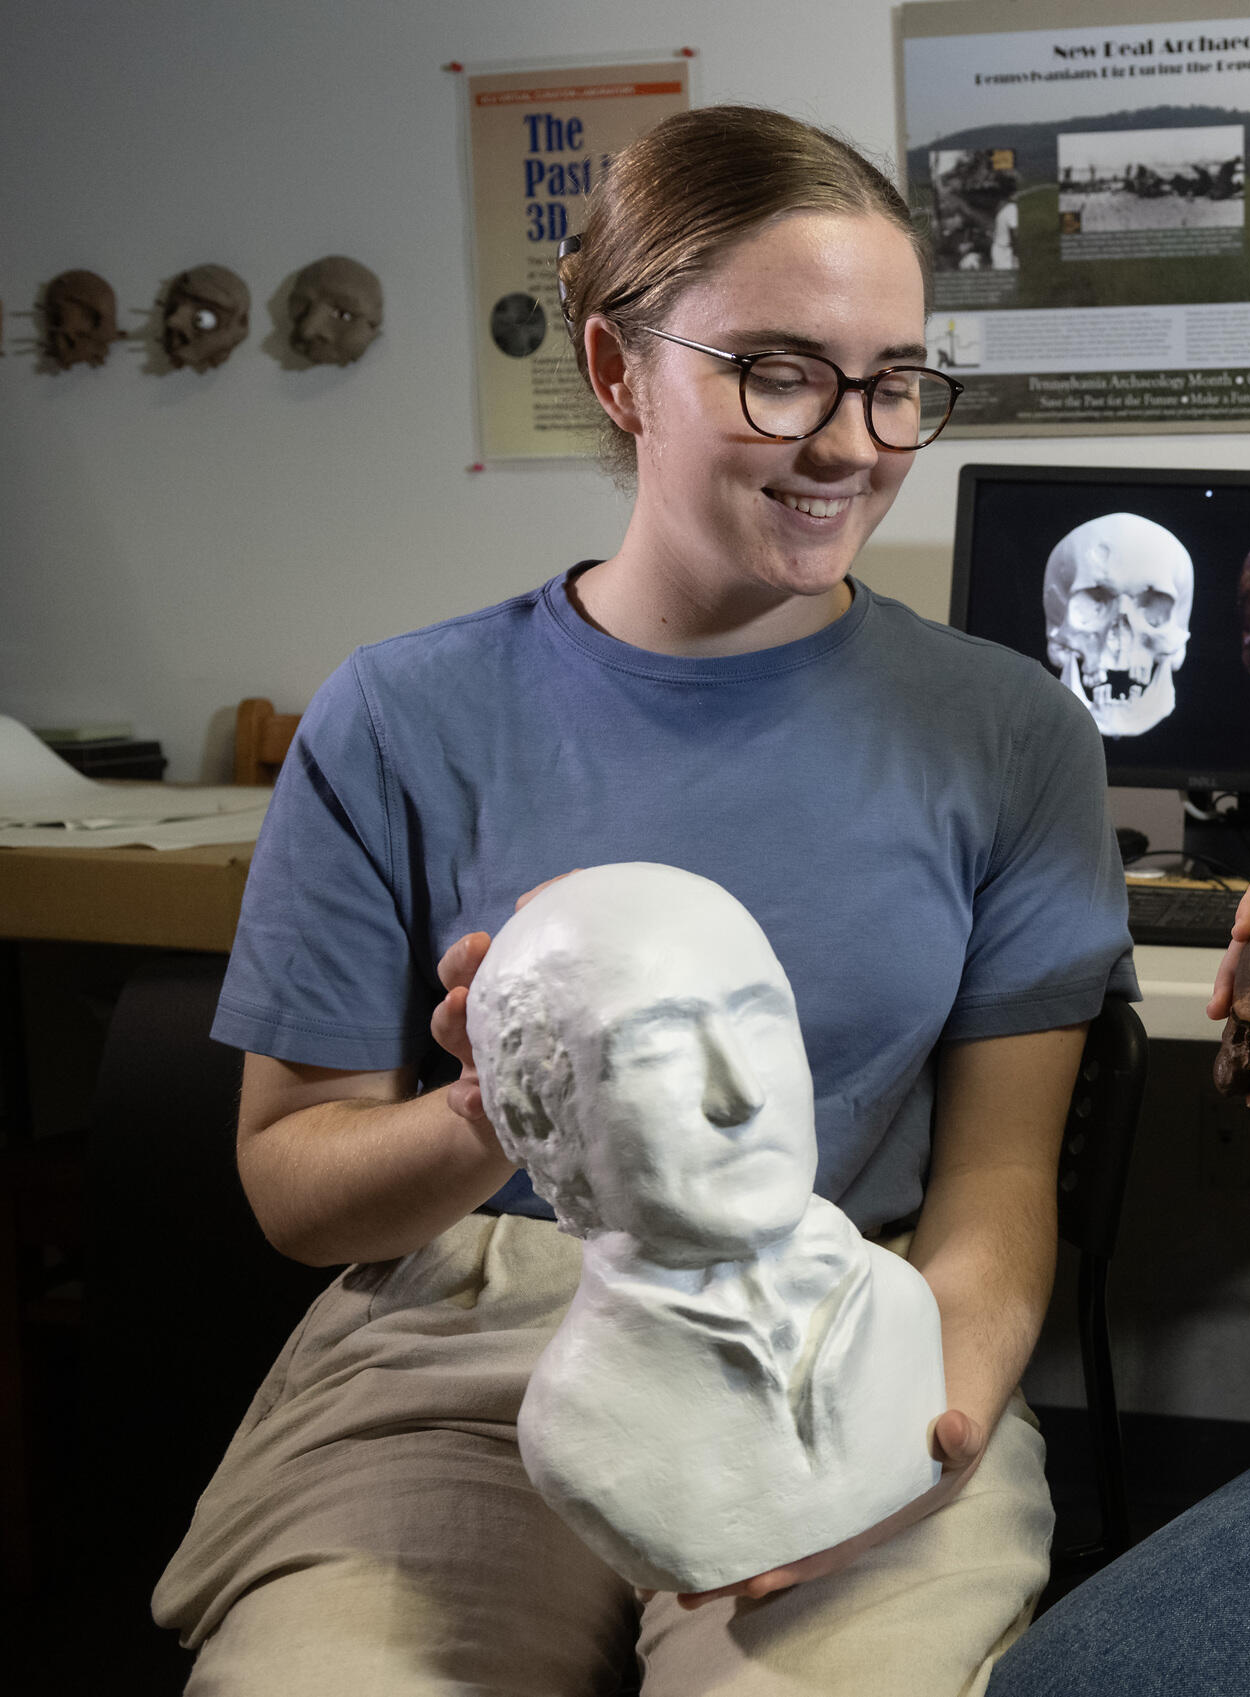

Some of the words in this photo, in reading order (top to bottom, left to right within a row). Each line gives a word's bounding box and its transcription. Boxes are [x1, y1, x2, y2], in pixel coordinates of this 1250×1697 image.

[1053, 45, 1097, 60] New
[1104, 38, 1154, 58] Deal
[1187, 61, 1212, 74] the
[523, 113, 584, 153] The
[524, 157, 591, 198] Past
[527, 202, 568, 242] 3D
[1029, 375, 1107, 392] Pennsylvania
[1110, 373, 1186, 391] Archaeology
[1187, 371, 1232, 387] Month
